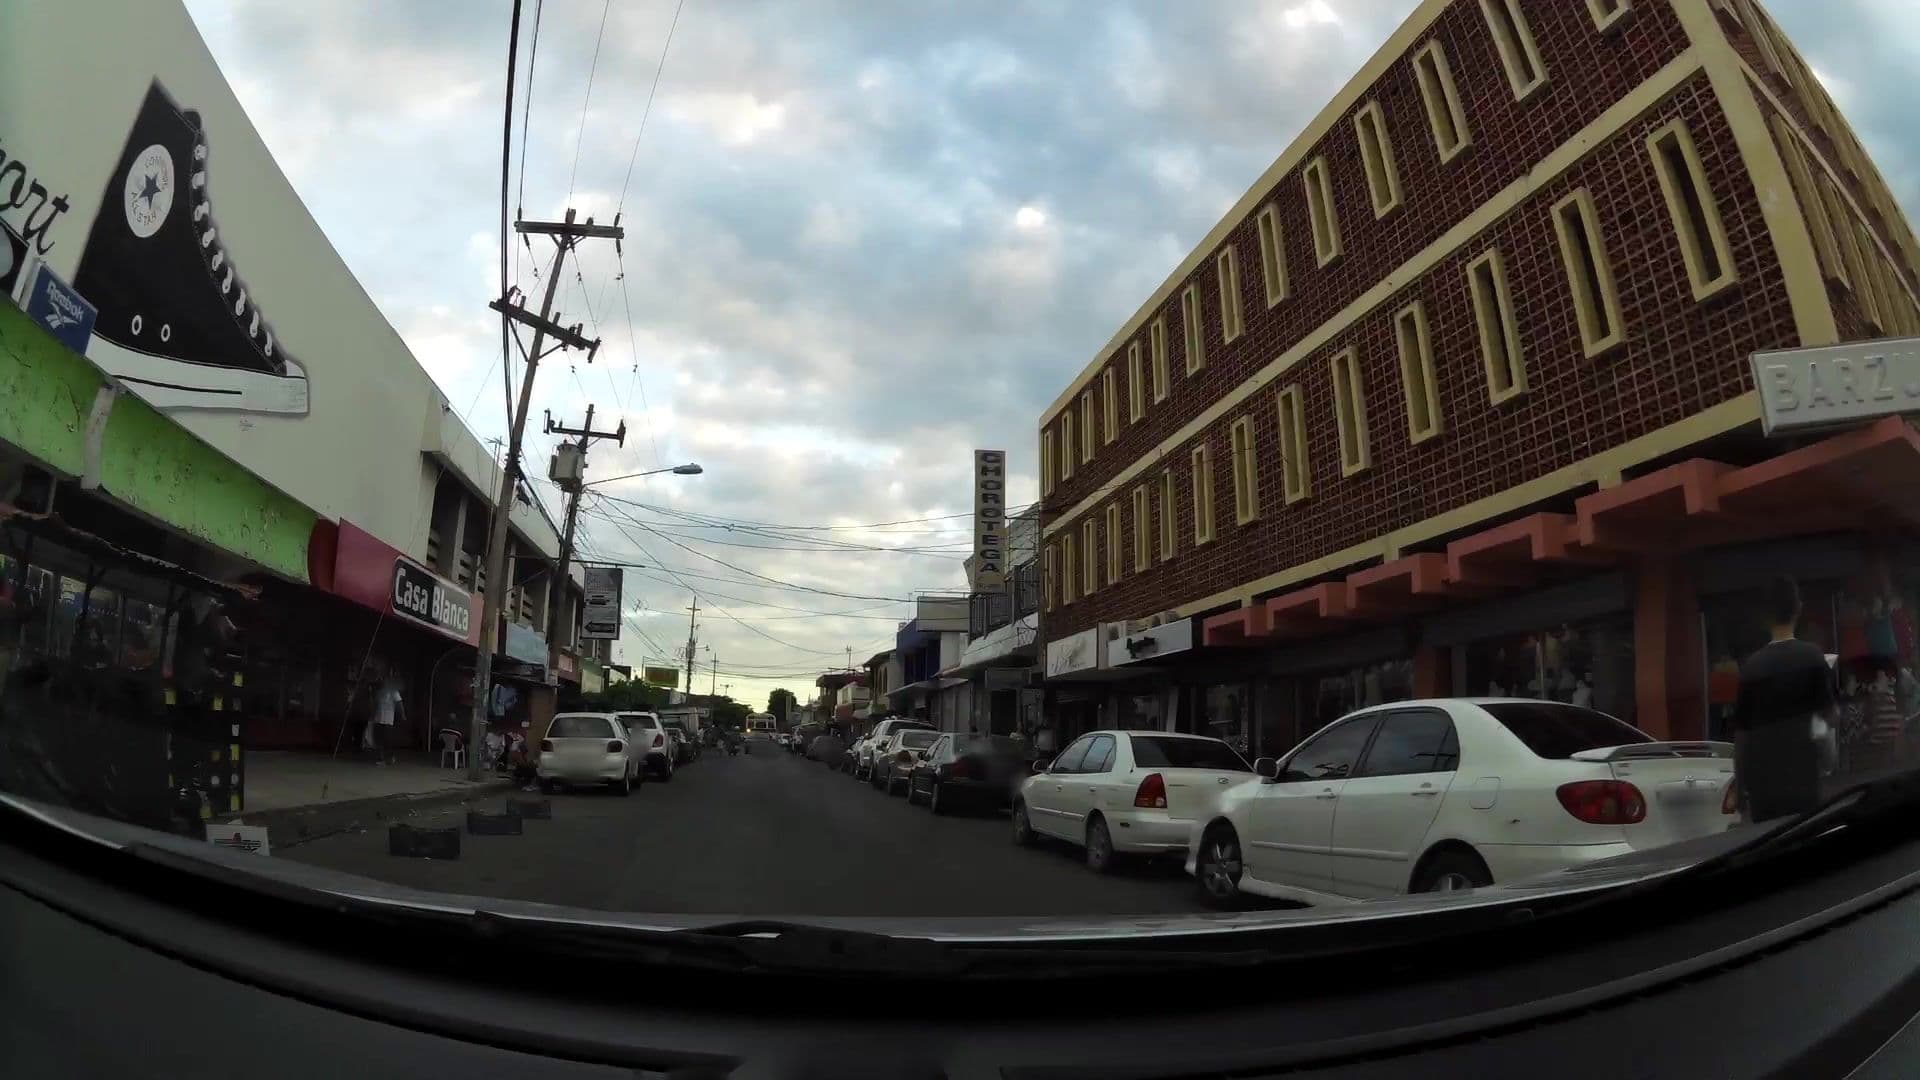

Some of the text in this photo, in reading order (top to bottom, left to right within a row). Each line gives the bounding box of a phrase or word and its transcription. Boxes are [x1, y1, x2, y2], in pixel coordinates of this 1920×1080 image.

[0, 147, 70, 255] art
[46, 280, 84, 321] Reebok
[980, 452, 1002, 573] CHOROTEGA
[395, 568, 469, 631] Casa Blanca
